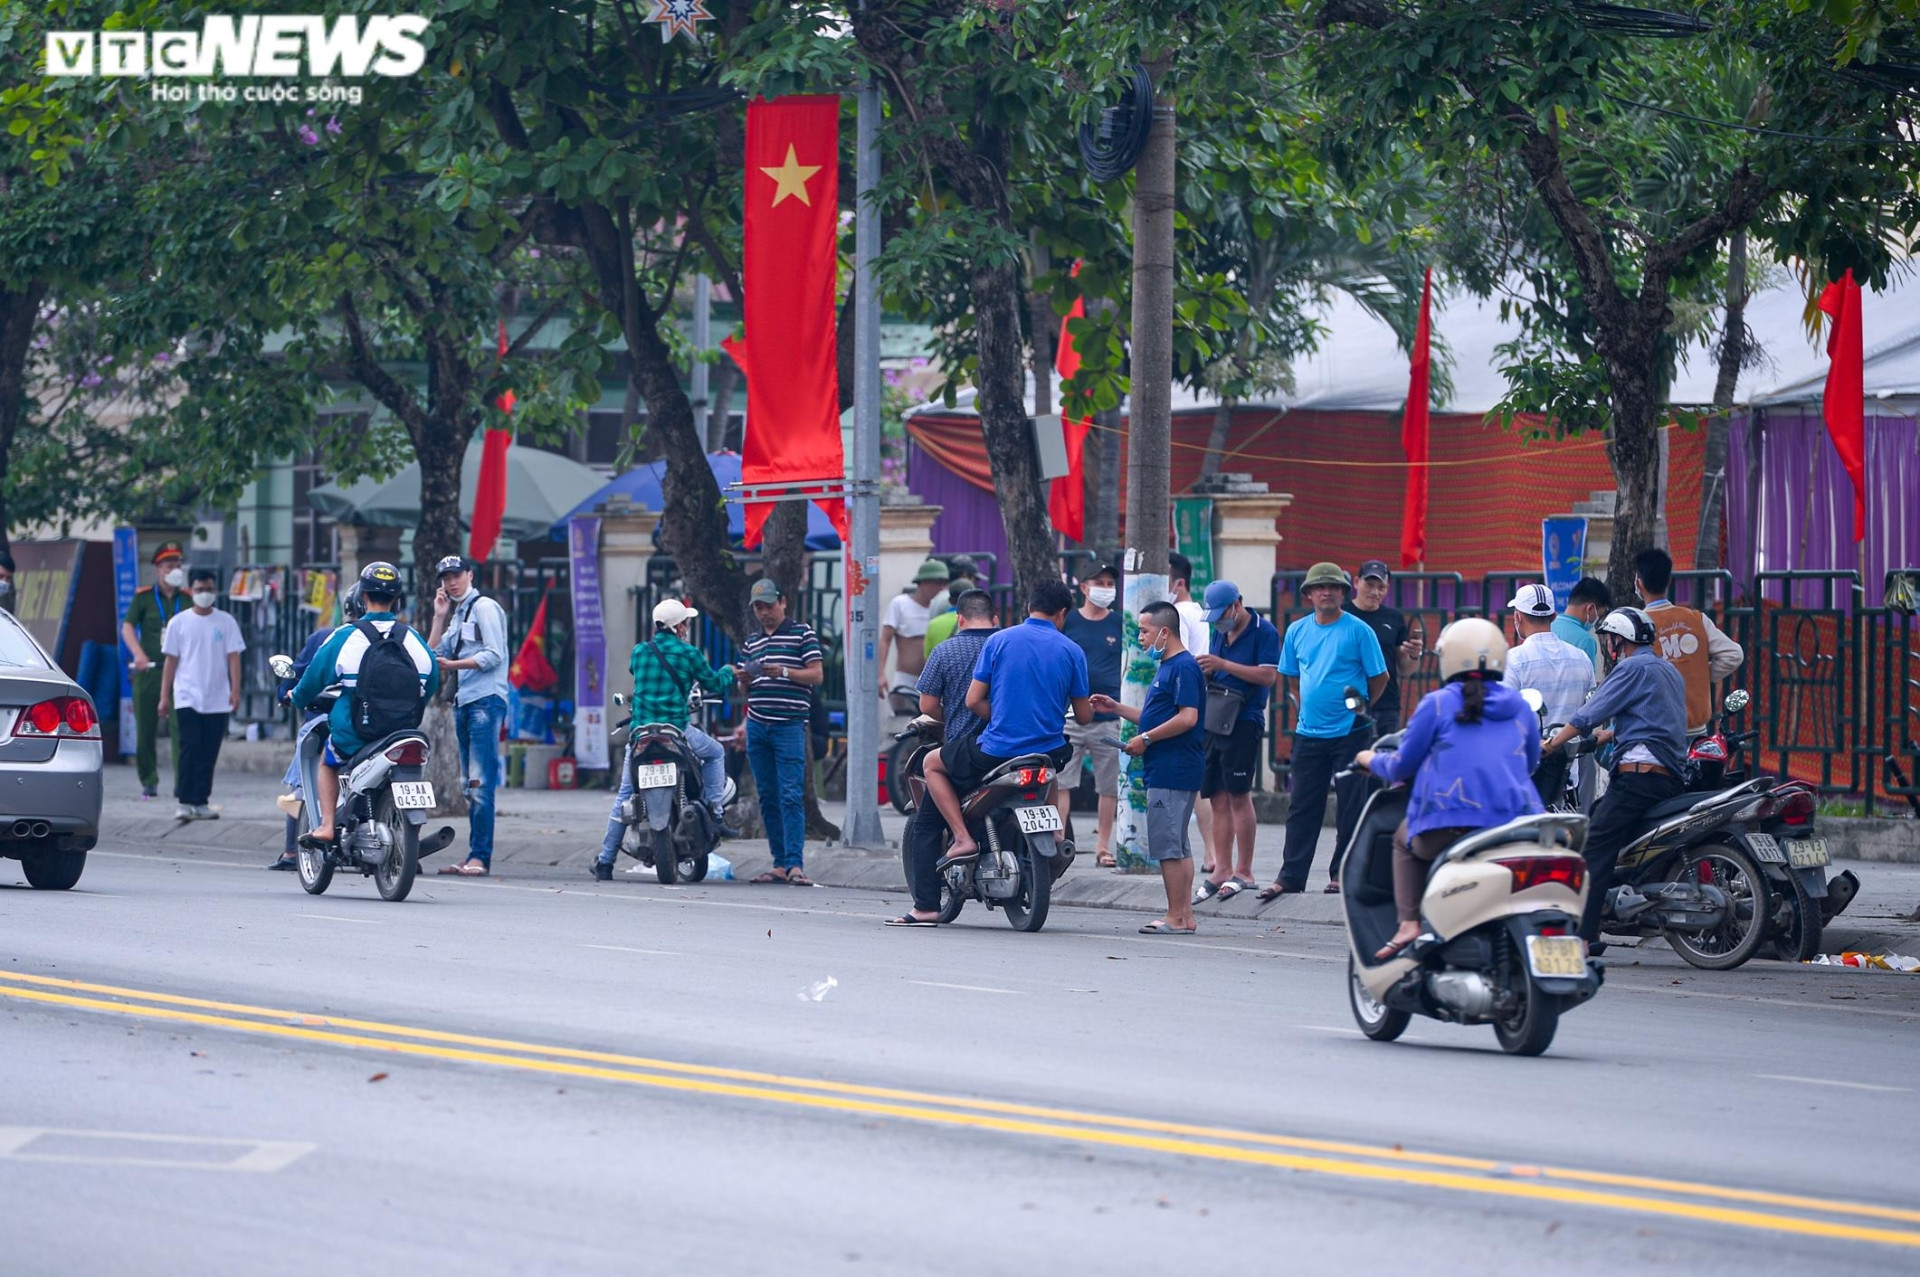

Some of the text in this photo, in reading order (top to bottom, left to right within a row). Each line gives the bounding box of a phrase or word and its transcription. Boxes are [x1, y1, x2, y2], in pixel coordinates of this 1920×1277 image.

[400, 784, 427, 795] 19-AA
[397, 795, 433, 807] 045.01
[1023, 807, 1052, 820] 19-B1
[1022, 817, 1058, 831] 204.77
[1792, 840, 1822, 854] 29-V3
[1792, 852, 1829, 867] 021.41
